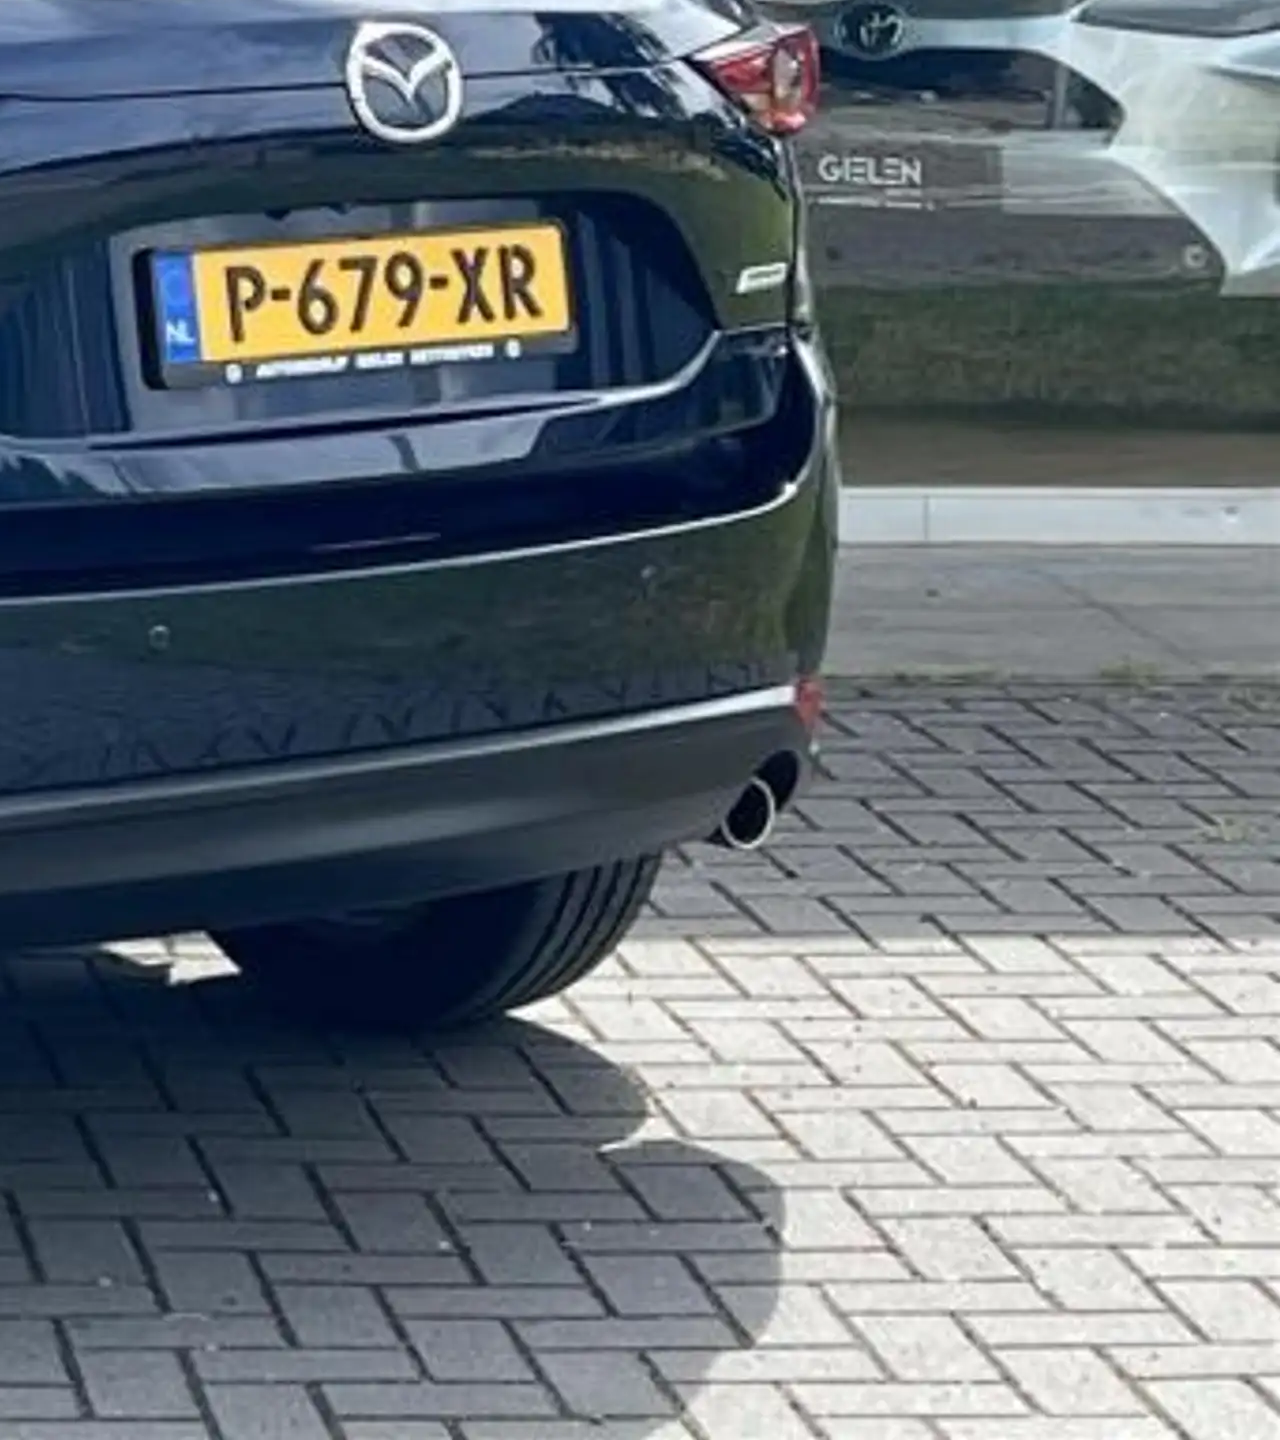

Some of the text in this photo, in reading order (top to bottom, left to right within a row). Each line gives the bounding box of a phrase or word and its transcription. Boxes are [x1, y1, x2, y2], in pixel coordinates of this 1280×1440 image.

[818, 154, 922, 186] GIELEN
[225, 245, 541, 343] P-679-XR
[165, 319, 195, 344] NL
